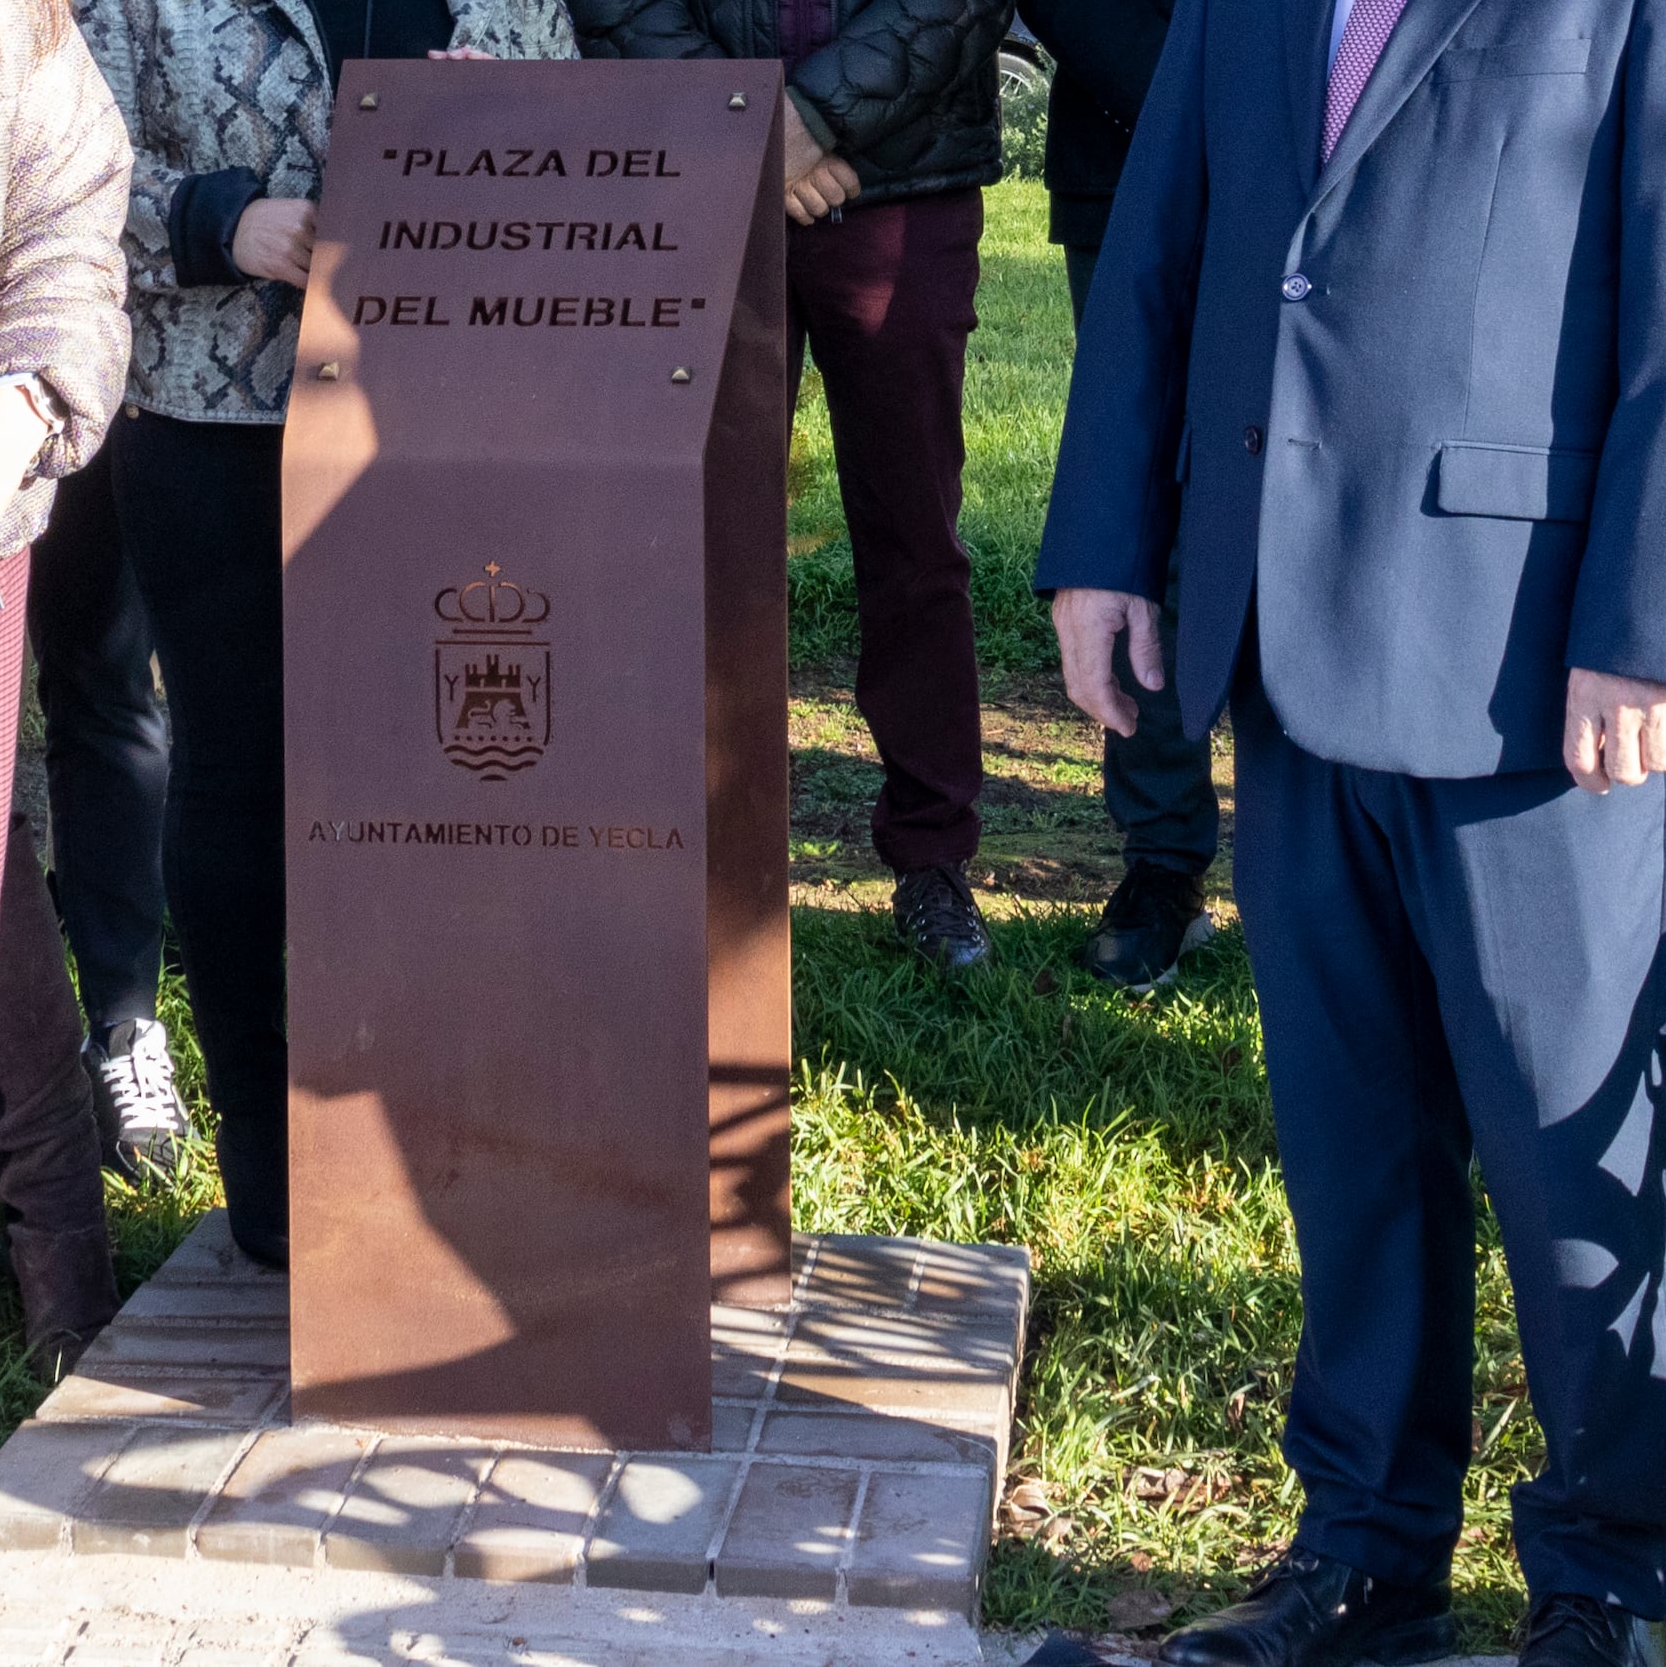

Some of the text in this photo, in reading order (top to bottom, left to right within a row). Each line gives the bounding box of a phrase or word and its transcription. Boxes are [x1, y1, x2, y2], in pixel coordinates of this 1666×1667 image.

[585, 149, 681, 178] DEL
[378, 220, 679, 251] INDUSTRIAL
[352, 295, 451, 327] DEL
[308, 820, 685, 850] AYUNTAMIENTO DE YECLA
